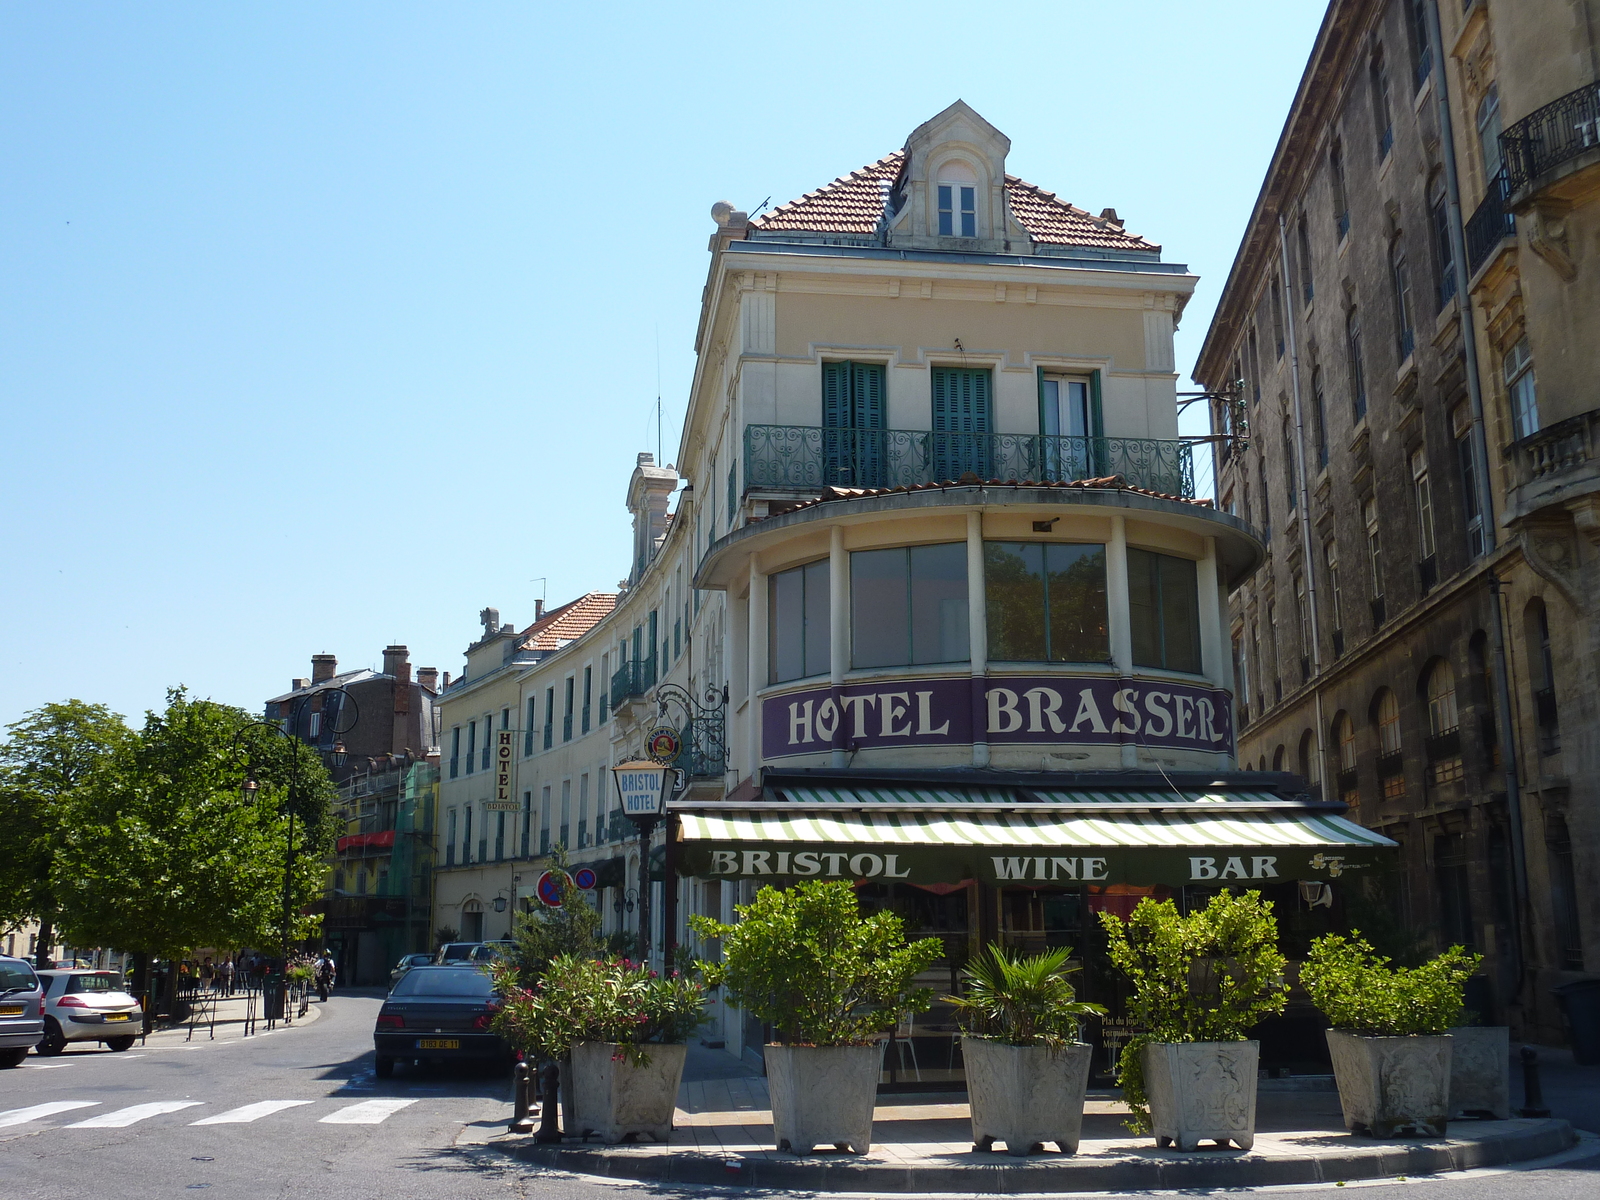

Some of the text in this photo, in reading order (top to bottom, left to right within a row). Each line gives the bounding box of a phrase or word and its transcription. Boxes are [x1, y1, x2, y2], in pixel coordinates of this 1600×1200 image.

[788, 691, 950, 745] HOTEL
[498, 733, 511, 800] HOTEL
[621, 773, 660, 792] BRISTOL
[487, 803, 518, 811] BRISTOL
[627, 794, 655, 811] HOTEL
[708, 850, 1280, 881] BRISTOL WINE BAR
[1101, 1016, 1114, 1025] Plat
[1116, 1016, 1124, 1025] du
[1102, 1028, 1128, 1037] Formule
